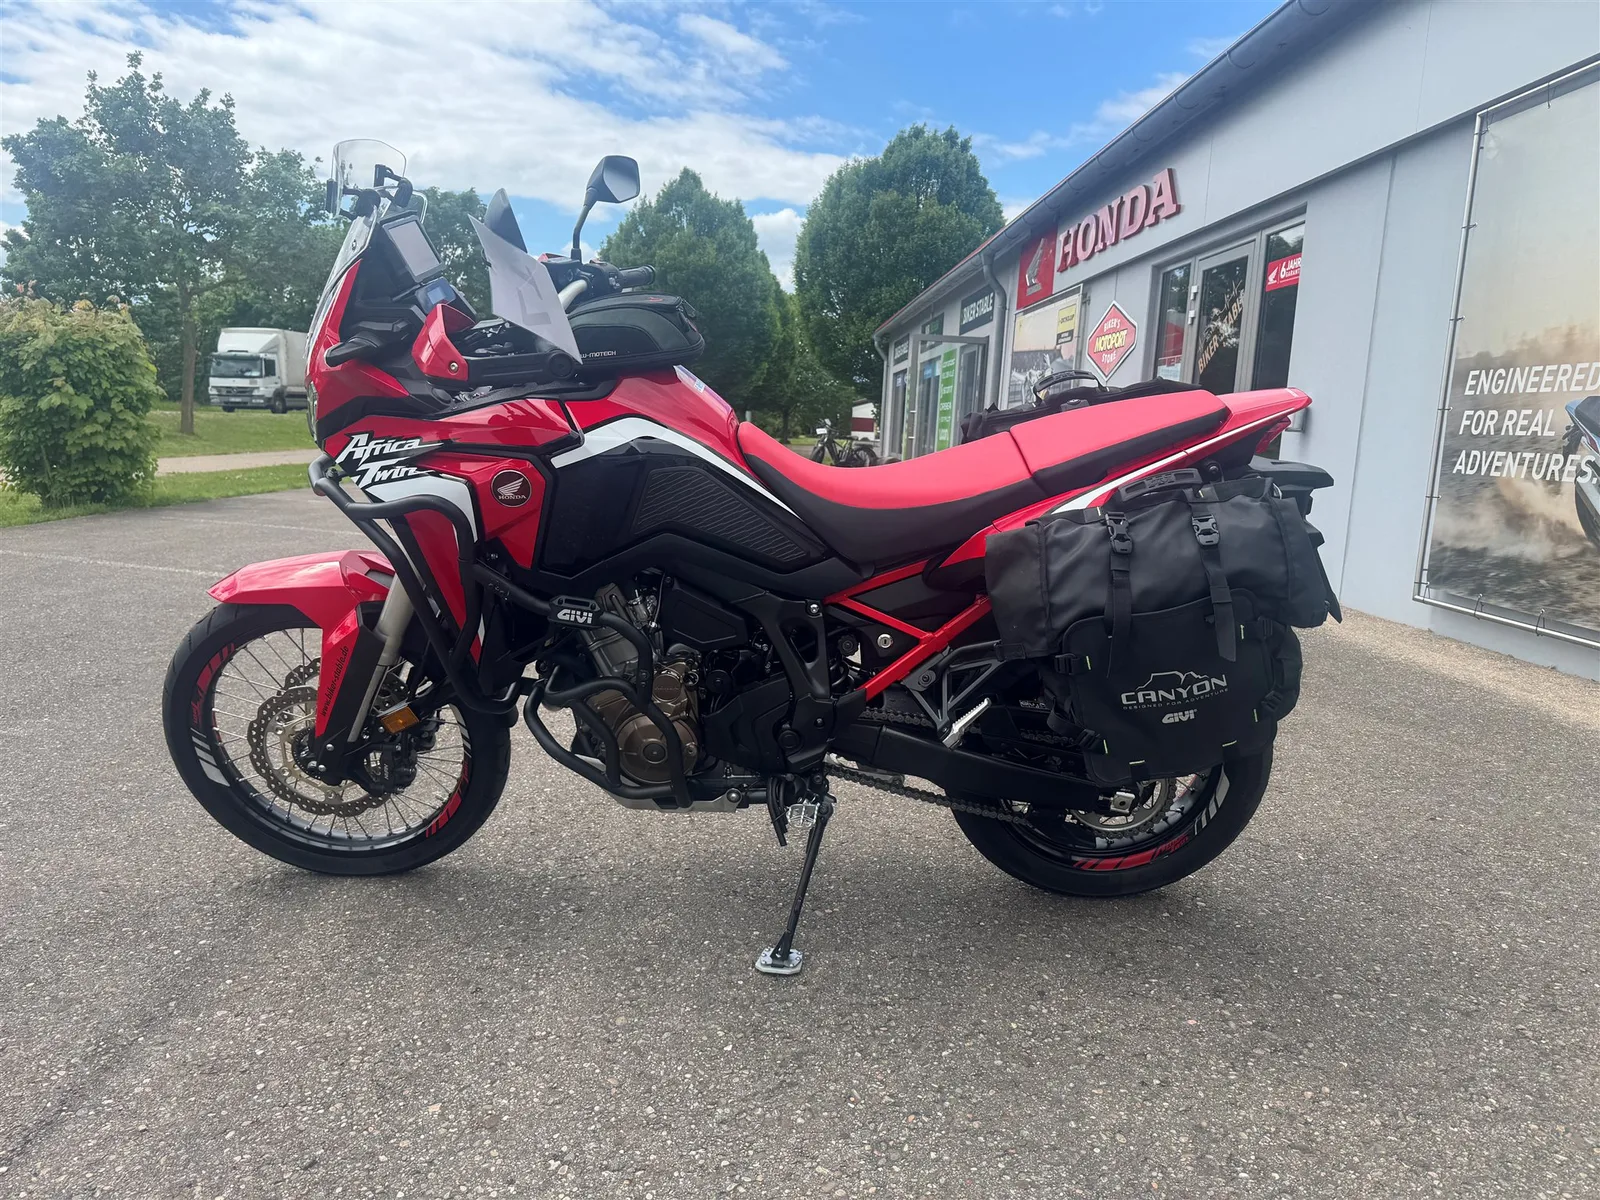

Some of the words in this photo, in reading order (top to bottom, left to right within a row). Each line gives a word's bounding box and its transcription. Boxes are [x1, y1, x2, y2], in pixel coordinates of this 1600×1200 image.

[1057, 168, 1181, 273] HONDA
[1280, 261, 1287, 279] 6
[1103, 317, 1121, 333] BIKER'S
[580, 350, 617, 359] W-MOTECH
[1093, 328, 1128, 354] MOTOPORT
[1197, 333, 1219, 375] BIKER
[1101, 350, 1117, 364] STORE
[1464, 361, 1600, 396] ENGINEERED
[1459, 409, 1499, 435] FOR
[1501, 408, 1556, 437] REAL
[335, 433, 444, 466] Africa
[355, 456, 436, 489] Twin
[1452, 449, 1598, 485] ADVENTURES.
[557, 608, 593, 624] GIVI
[321, 645, 349, 717] www.biker-stable.de
[1121, 674, 1228, 705] CANYON
[1185, 688, 1229, 703] ADVENTURE
[1162, 709, 1195, 724] GIVI
